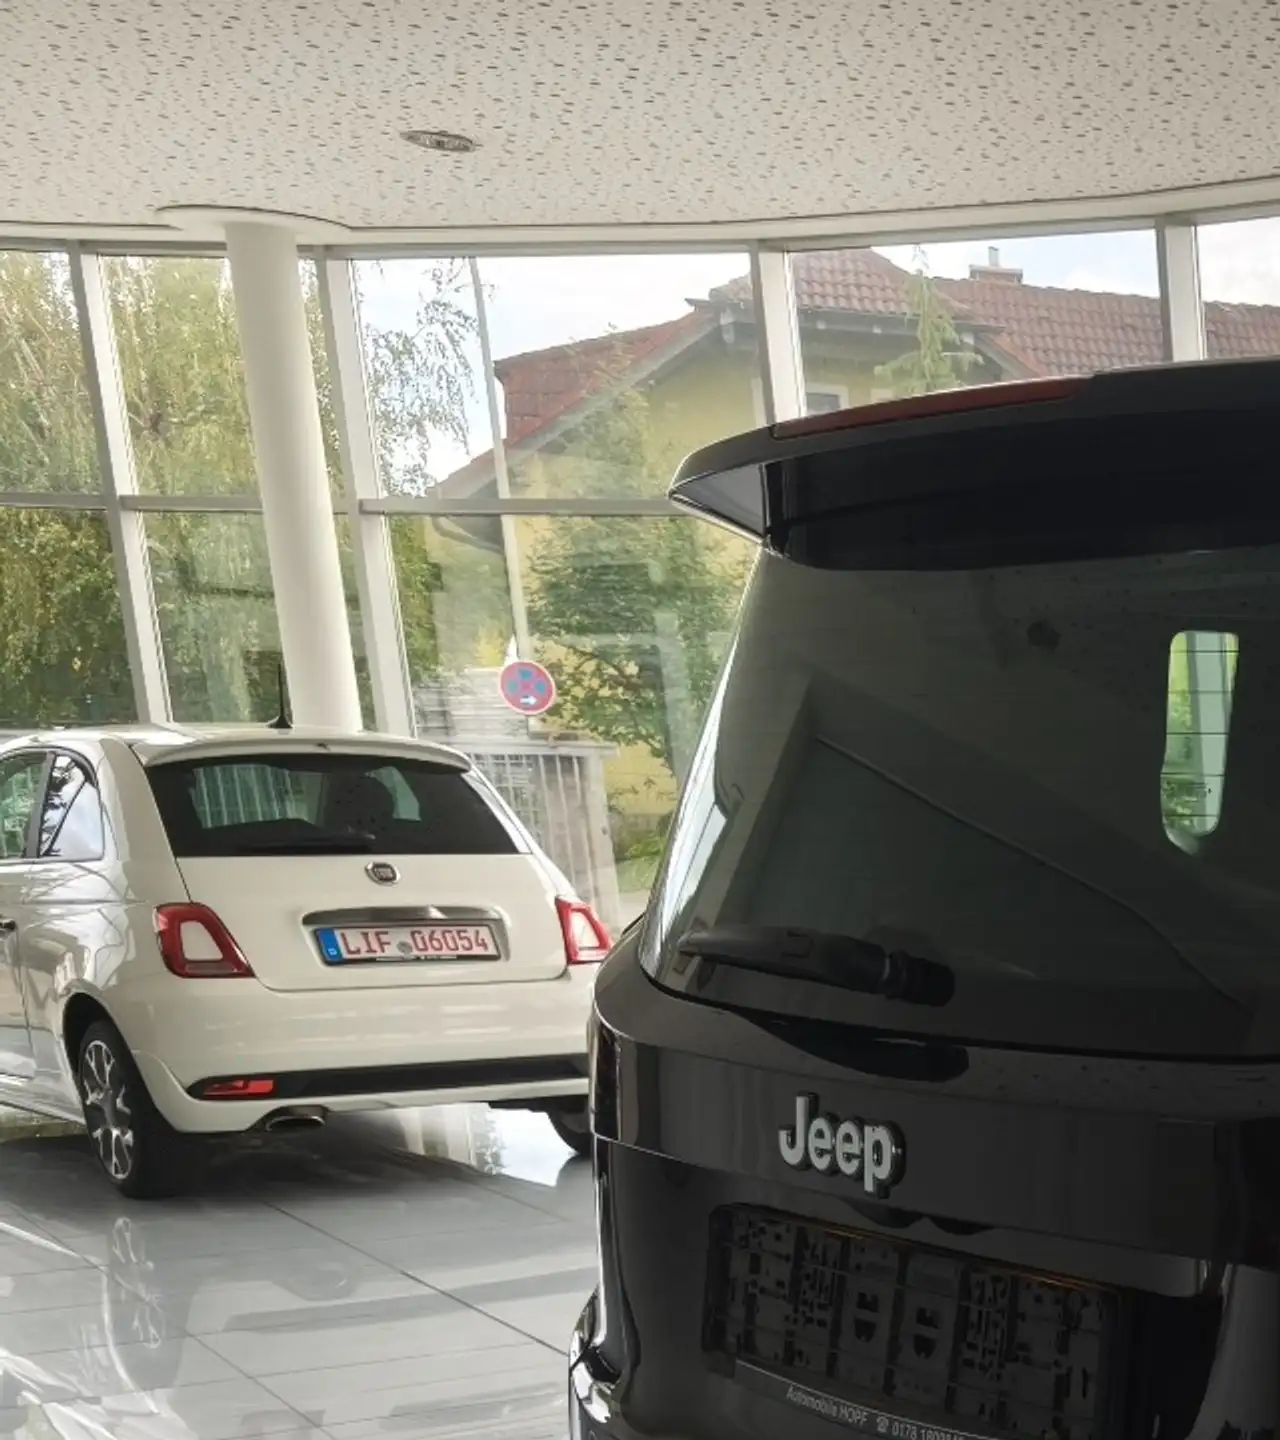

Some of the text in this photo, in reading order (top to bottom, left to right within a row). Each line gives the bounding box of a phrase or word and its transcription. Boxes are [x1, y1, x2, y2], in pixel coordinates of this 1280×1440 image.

[340, 929, 489, 955] LIF 06054
[778, 1094, 897, 1194] Jeep
